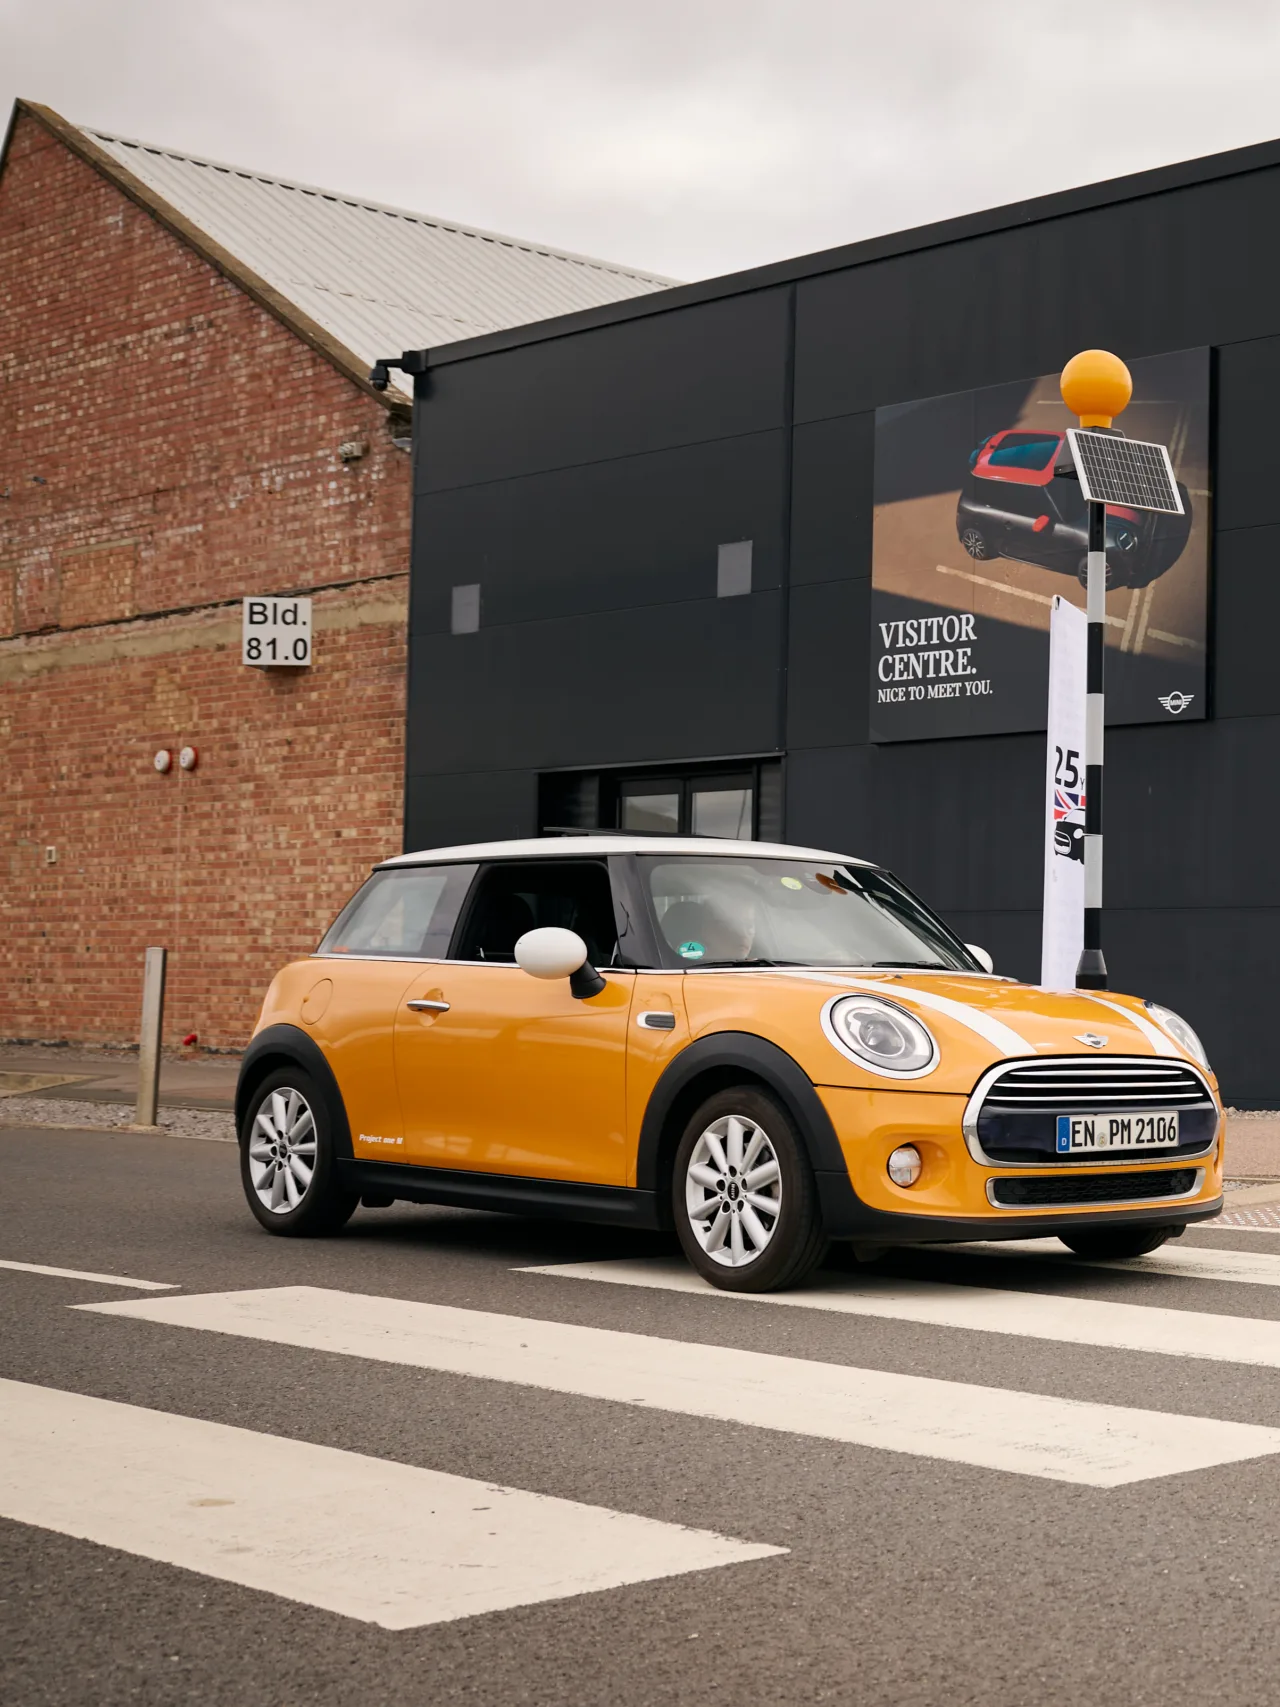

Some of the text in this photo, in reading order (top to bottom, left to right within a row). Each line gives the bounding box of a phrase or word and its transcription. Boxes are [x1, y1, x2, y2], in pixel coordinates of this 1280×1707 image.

[248, 602, 308, 626] Bld.
[878, 613, 978, 649] VISITOR
[246, 637, 308, 661] 81.0
[877, 647, 977, 682] CENTRE.
[877, 679, 994, 703] NICE TO MEET YOU.
[1055, 745, 1086, 791] 25 Y
[687, 942, 696, 951] 4
[1061, 1137, 1067, 1146] D
[1071, 1116, 1177, 1148] EN PM 2106
